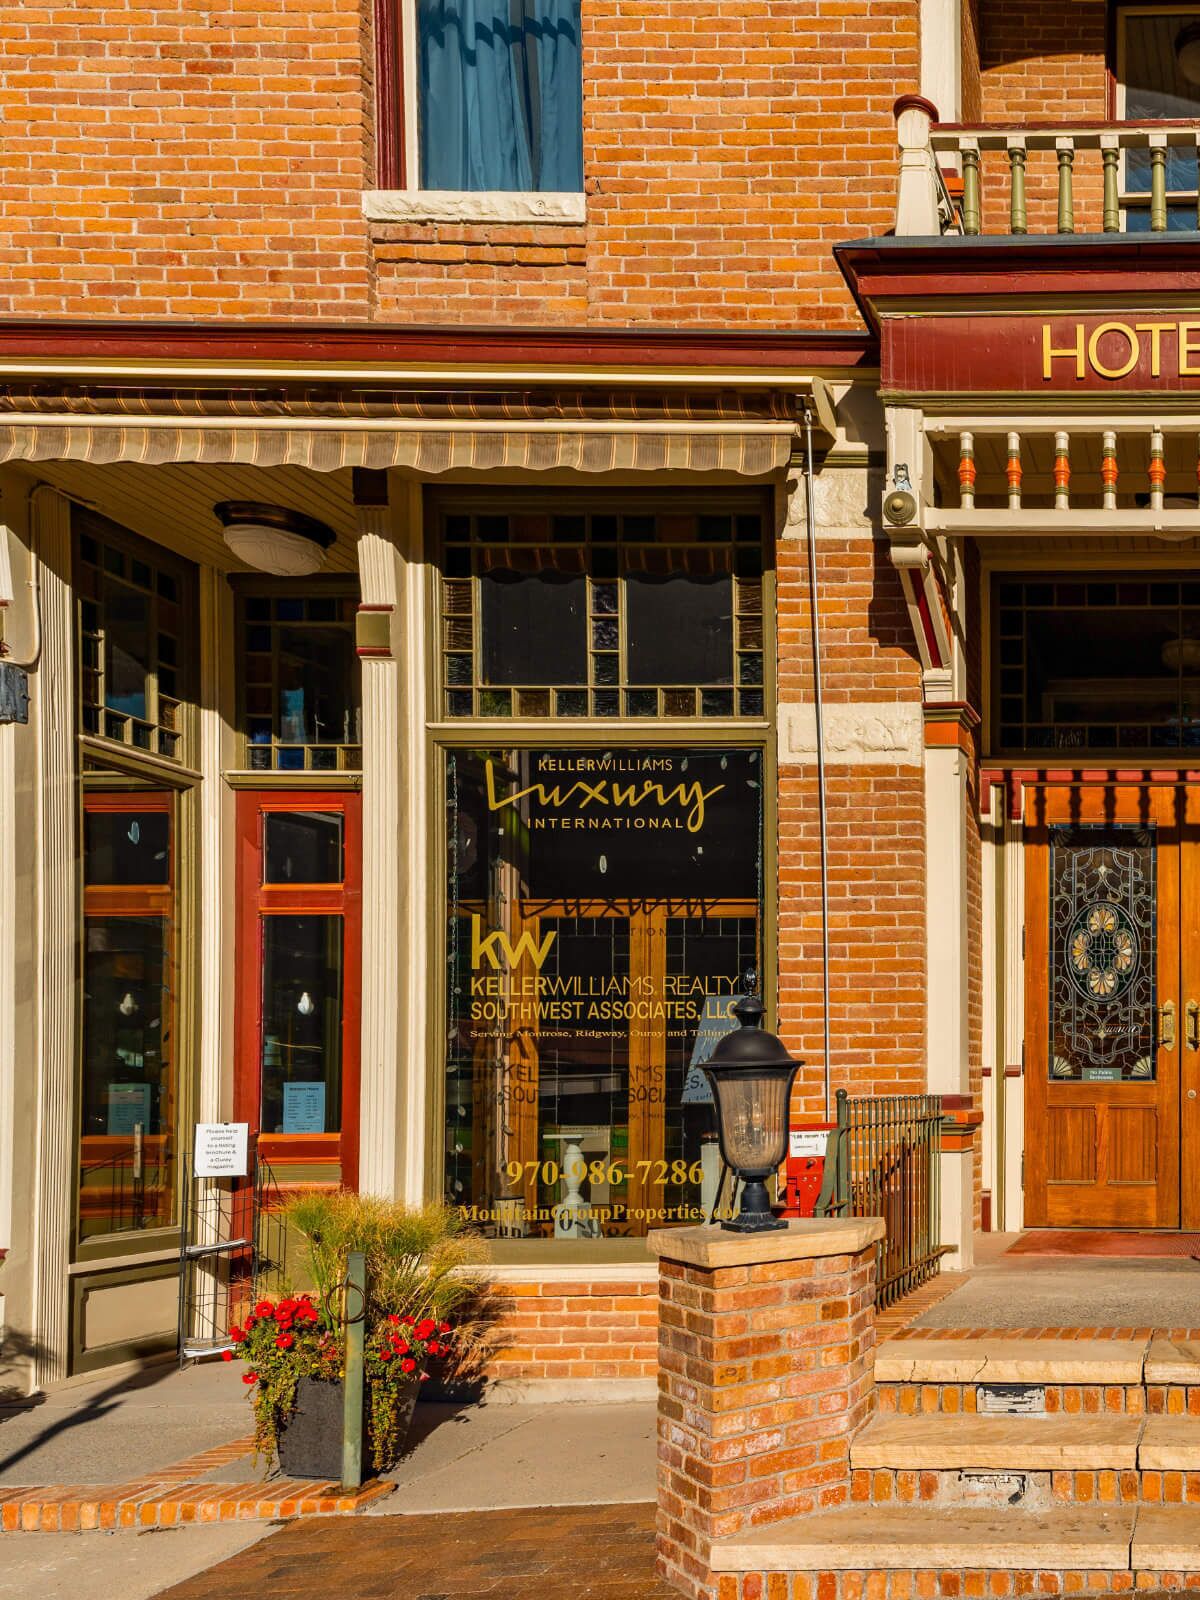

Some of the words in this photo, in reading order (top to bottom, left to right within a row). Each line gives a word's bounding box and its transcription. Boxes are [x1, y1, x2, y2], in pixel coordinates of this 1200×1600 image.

[486, 759, 726, 832] Luxury
[527, 818, 684, 829] INTERNATIONAL
[662, 976, 740, 996] REALTY
[470, 1001, 586, 1020] SOUTHWEST
[587, 1001, 701, 1020] ASSOCIATES,
[470, 1030, 514, 1038] Serving
[516, 1030, 573, 1038] Montrose,
[575, 1030, 628, 1039] Ridgway,
[630, 1030, 664, 1038] Ouray
[690, 1029, 734, 1038] Tellurid
[507, 1160, 704, 1186] 970-986-7286
[459, 1204, 740, 1224] MountainGroupProperties.co
